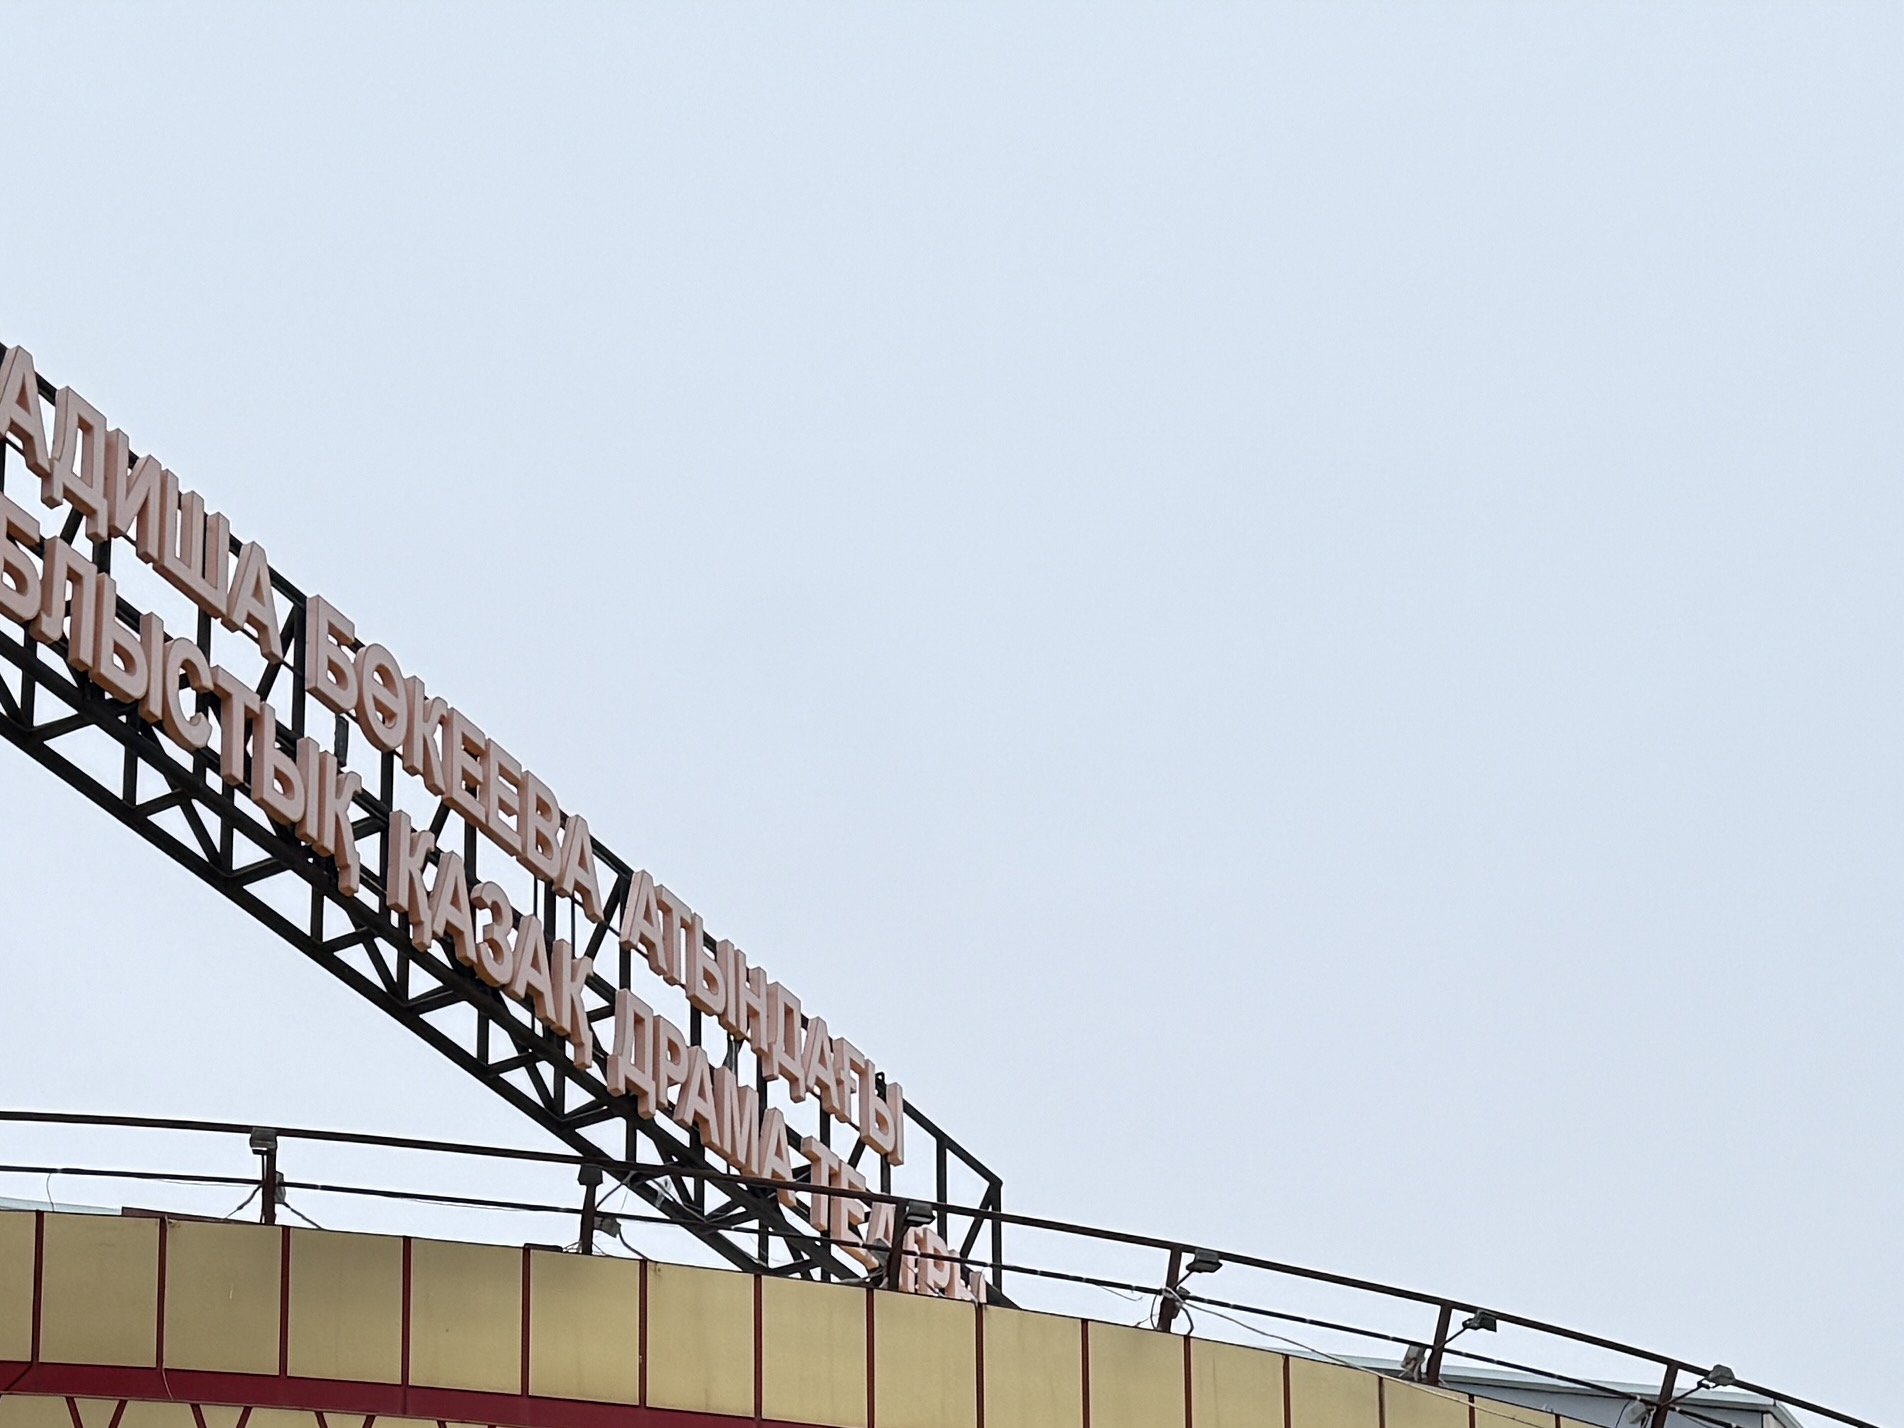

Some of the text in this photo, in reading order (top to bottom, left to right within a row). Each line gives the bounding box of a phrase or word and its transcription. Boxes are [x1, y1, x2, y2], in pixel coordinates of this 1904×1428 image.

[306, 594, 604, 923] БӨКЕЕВА
[620, 868, 903, 1166] АТЫНДАҒЫ
[386, 808, 593, 1070] ҚАЗАҚ
[607, 988, 797, 1208] ДРАМА
